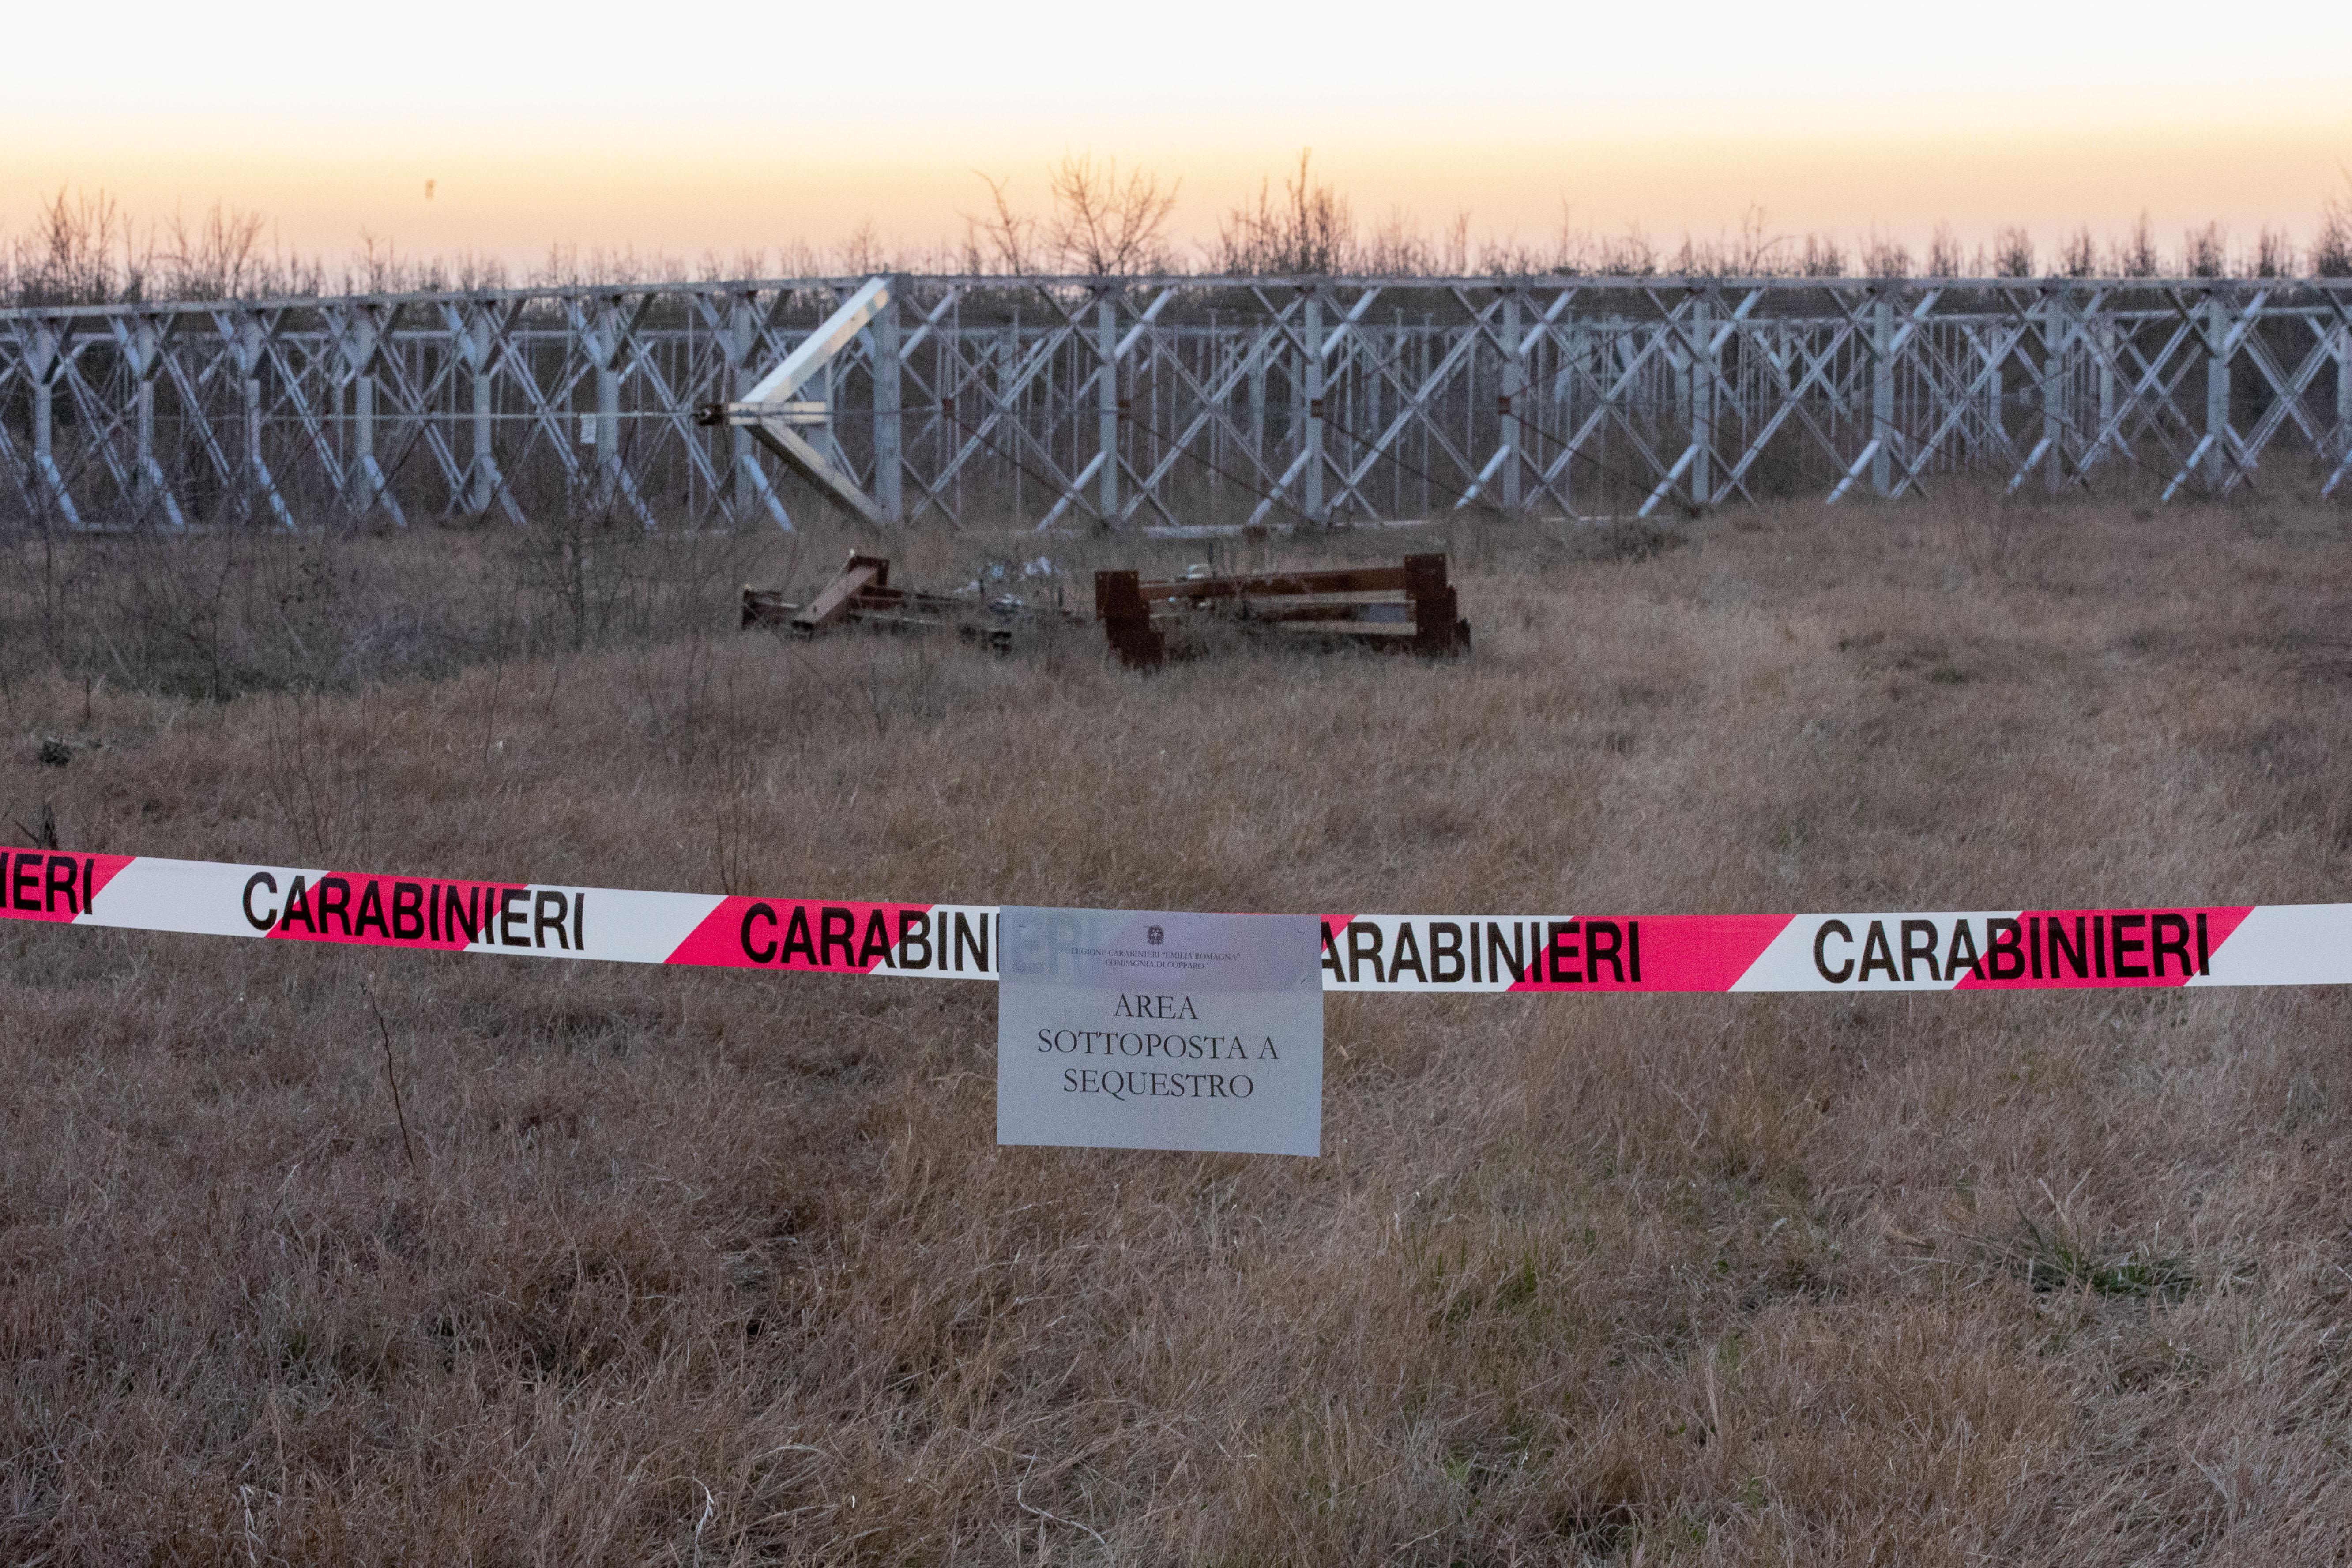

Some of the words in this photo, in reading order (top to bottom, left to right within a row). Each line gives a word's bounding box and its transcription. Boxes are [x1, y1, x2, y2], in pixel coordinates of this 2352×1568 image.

[242, 871, 585, 951] CARABINIERI
[1321, 921, 1641, 983] ARABINIERI
[1814, 913, 2210, 984] CARABINIERI
[1114, 993, 1199, 1019] AREA
[1038, 1029, 1248, 1060] SOTTOPOSTA
[1259, 1035, 1280, 1060] A
[1063, 1068, 1254, 1101] SEQUESTRO
